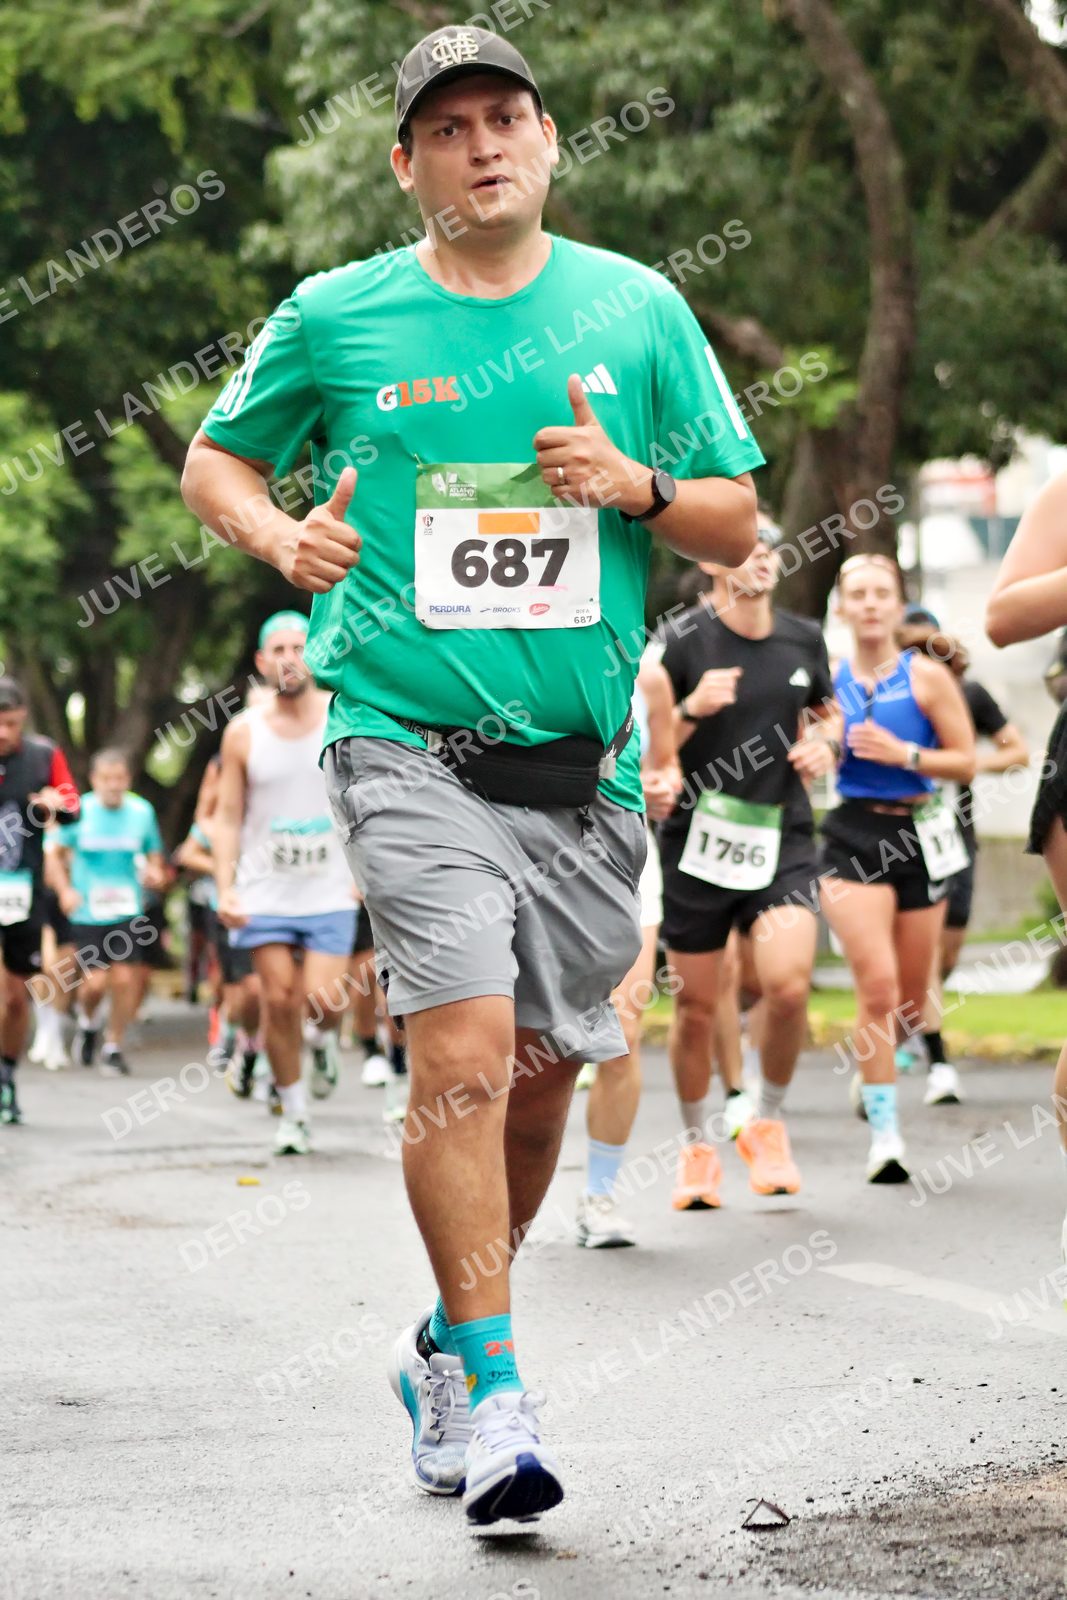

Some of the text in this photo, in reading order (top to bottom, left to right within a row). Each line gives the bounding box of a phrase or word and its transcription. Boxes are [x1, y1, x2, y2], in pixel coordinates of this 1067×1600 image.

[451, 538, 570, 588] 687
[429, 605, 472, 613] PERDURA
[492, 606, 521, 614] BROOKS
[573, 615, 593, 624] 687
[699, 830, 766, 868] 1766
